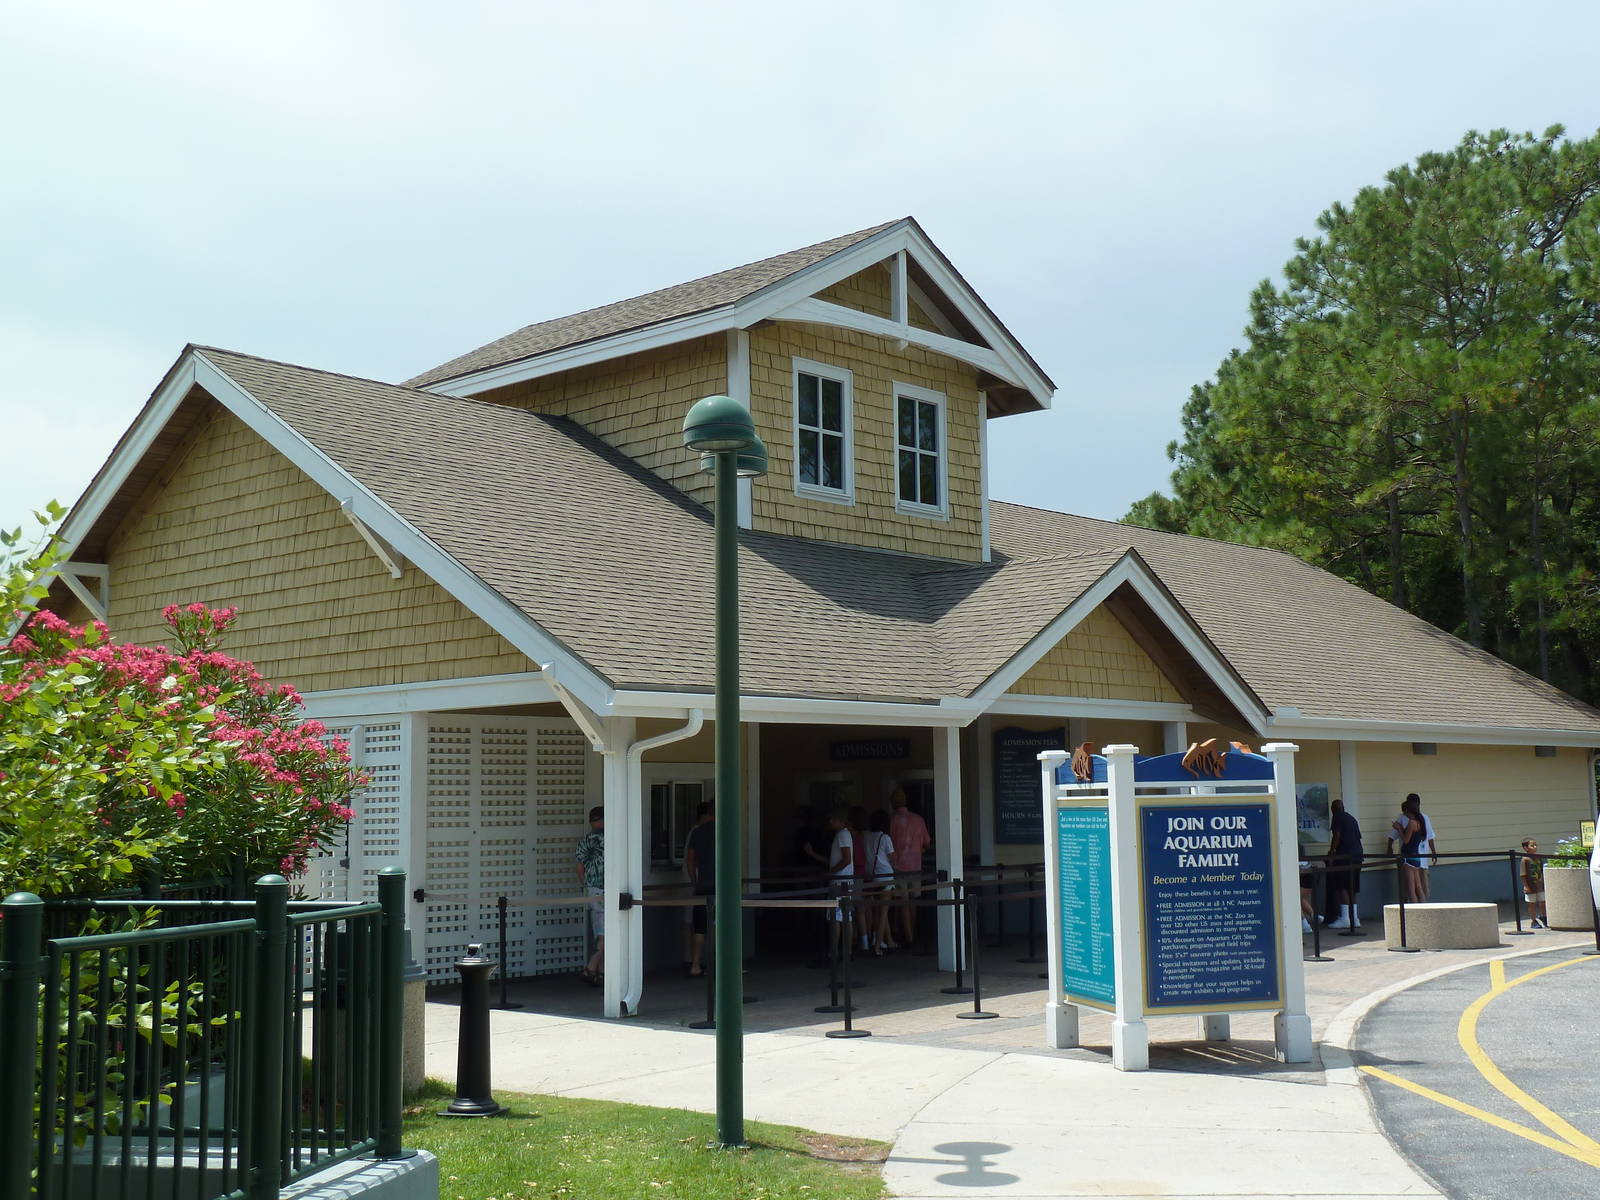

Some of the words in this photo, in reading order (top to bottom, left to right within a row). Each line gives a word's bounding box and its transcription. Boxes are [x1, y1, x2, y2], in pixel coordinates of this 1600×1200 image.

[835, 743, 904, 757] ADMISSIONS
[1168, 818, 1204, 833] JOIN
[1210, 816, 1248, 830] OUR
[1164, 835, 1253, 852] AQUARIUM
[1178, 854, 1240, 868] FAMILY!
[1153, 875, 1188, 884] Become
[1200, 873, 1236, 883] Member
[1240, 872, 1264, 882] Today
[1159, 891, 1172, 899] Enjoy
[1243, 933, 1257, 941] Shop
